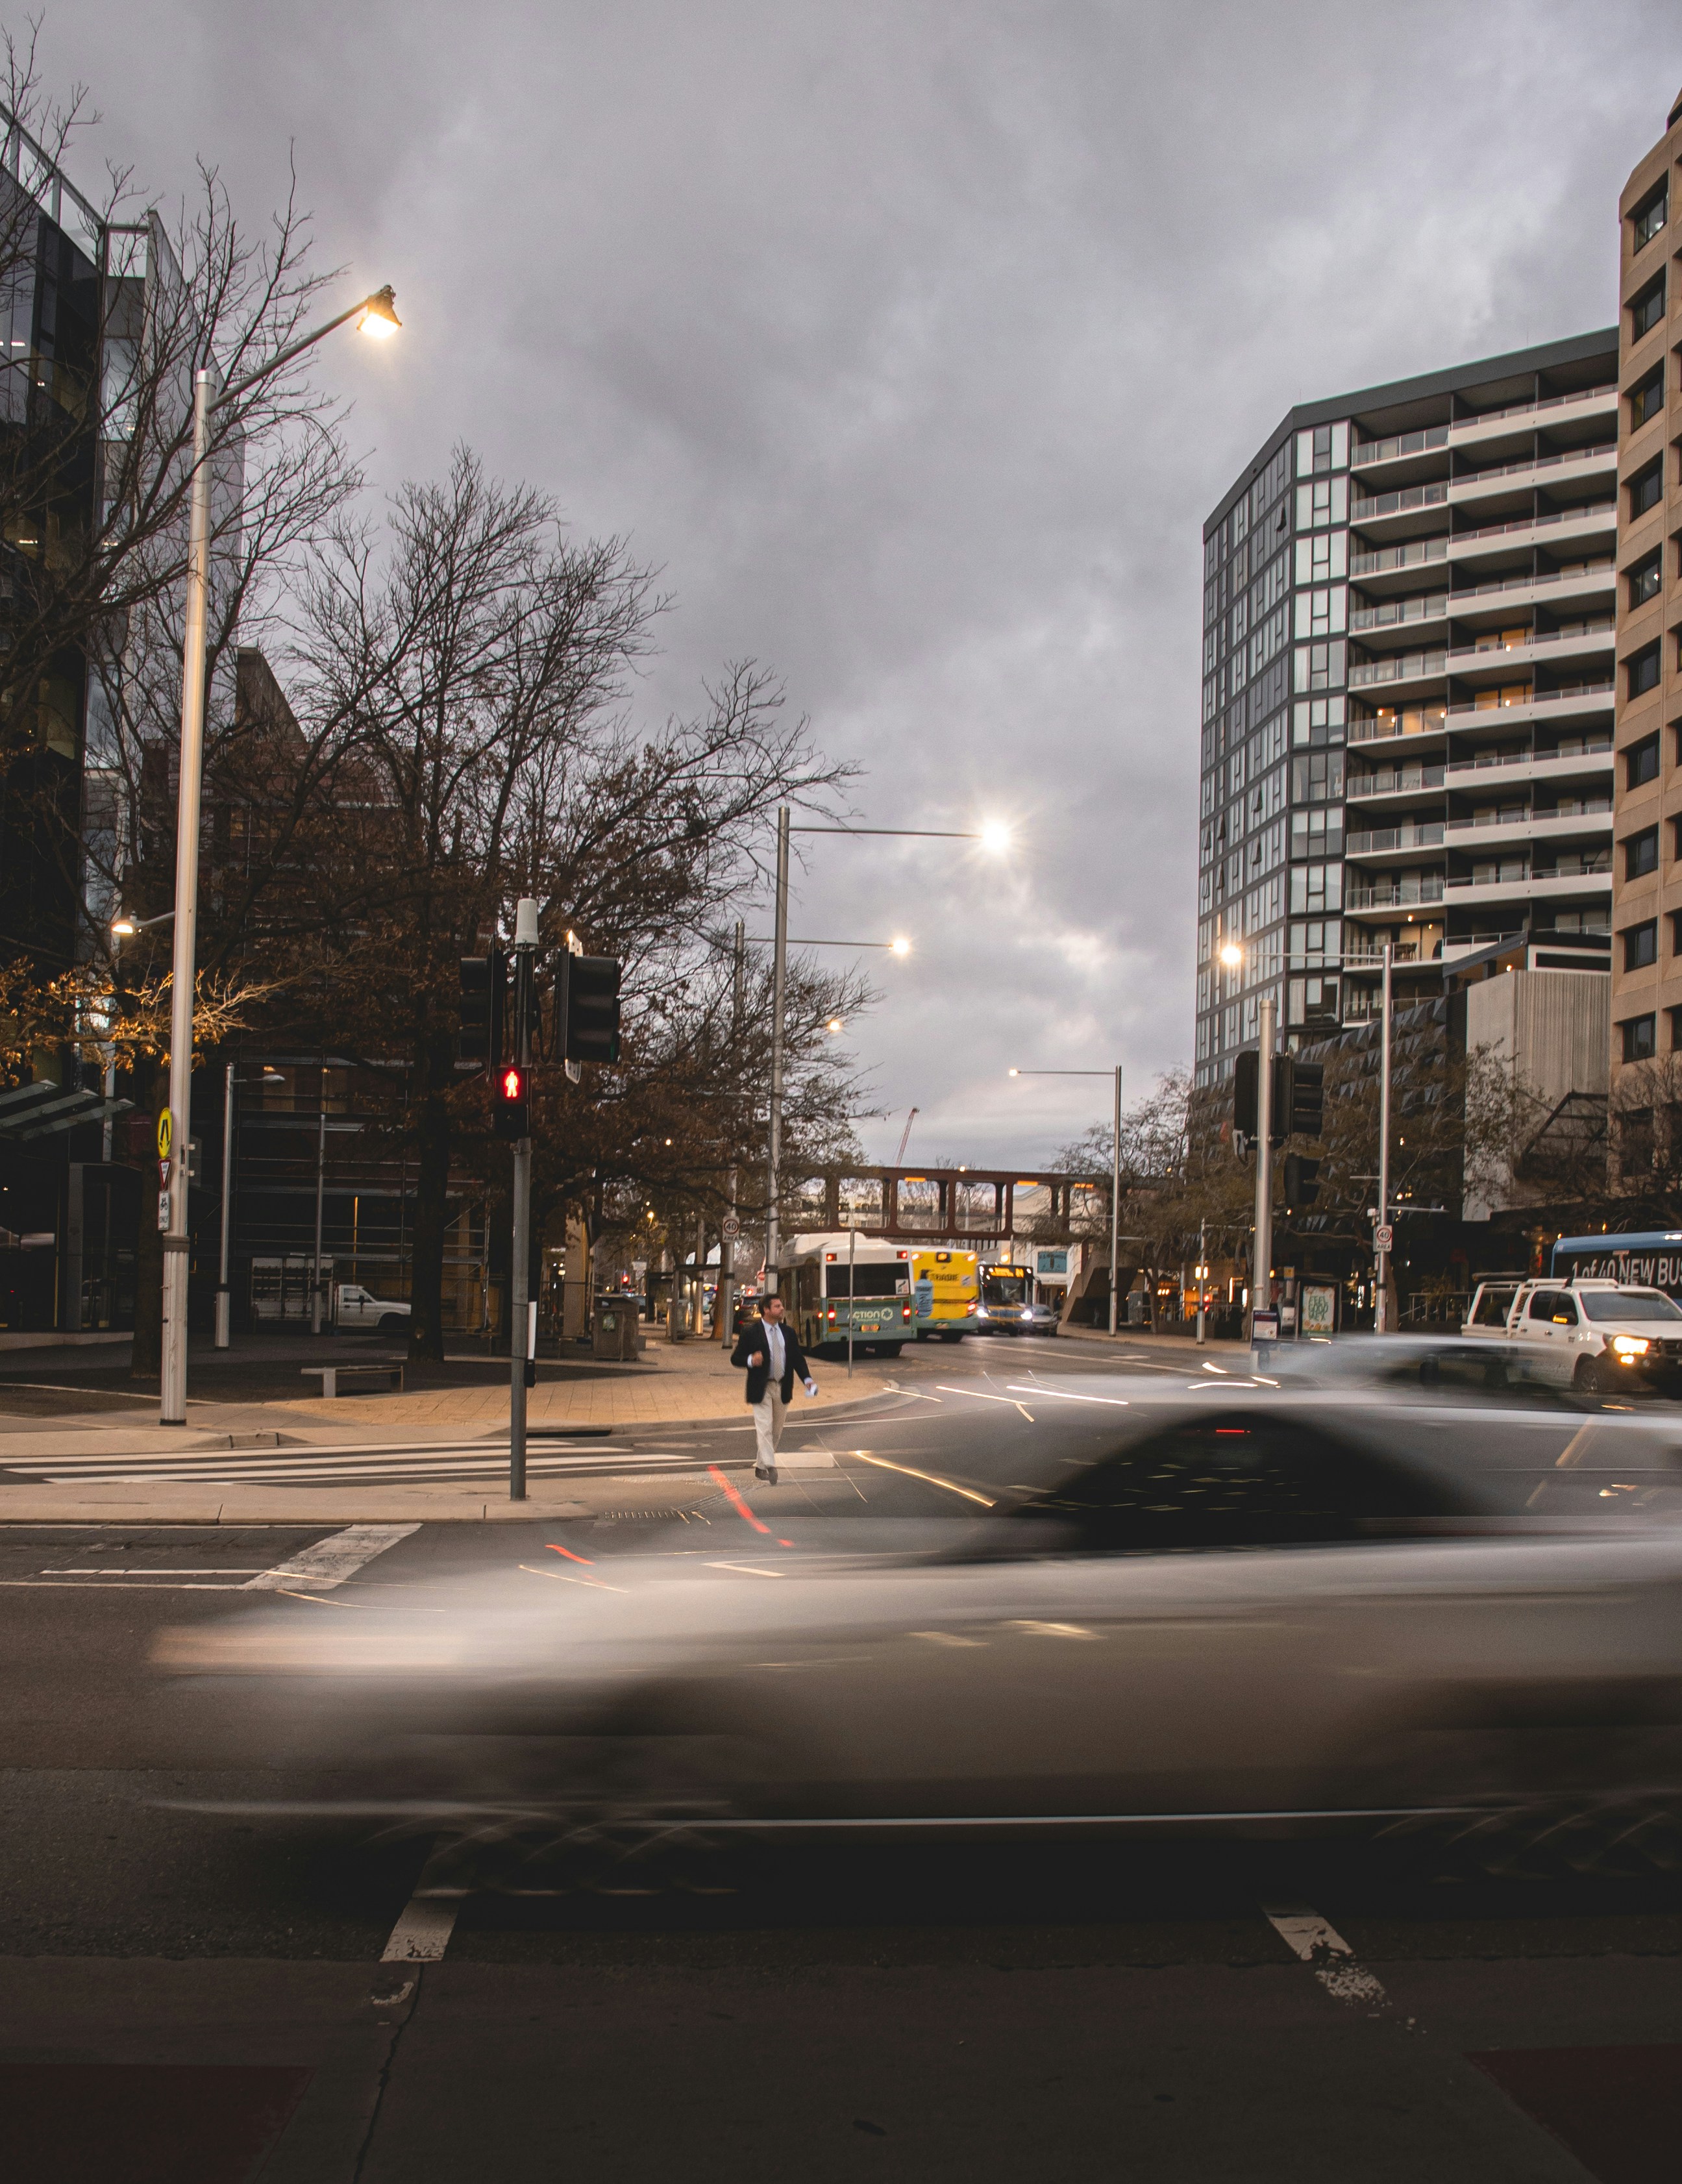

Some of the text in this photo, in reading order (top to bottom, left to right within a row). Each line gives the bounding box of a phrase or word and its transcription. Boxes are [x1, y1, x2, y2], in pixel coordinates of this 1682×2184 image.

[1572, 1257, 1682, 1285] 1 of 40 NEW BU
